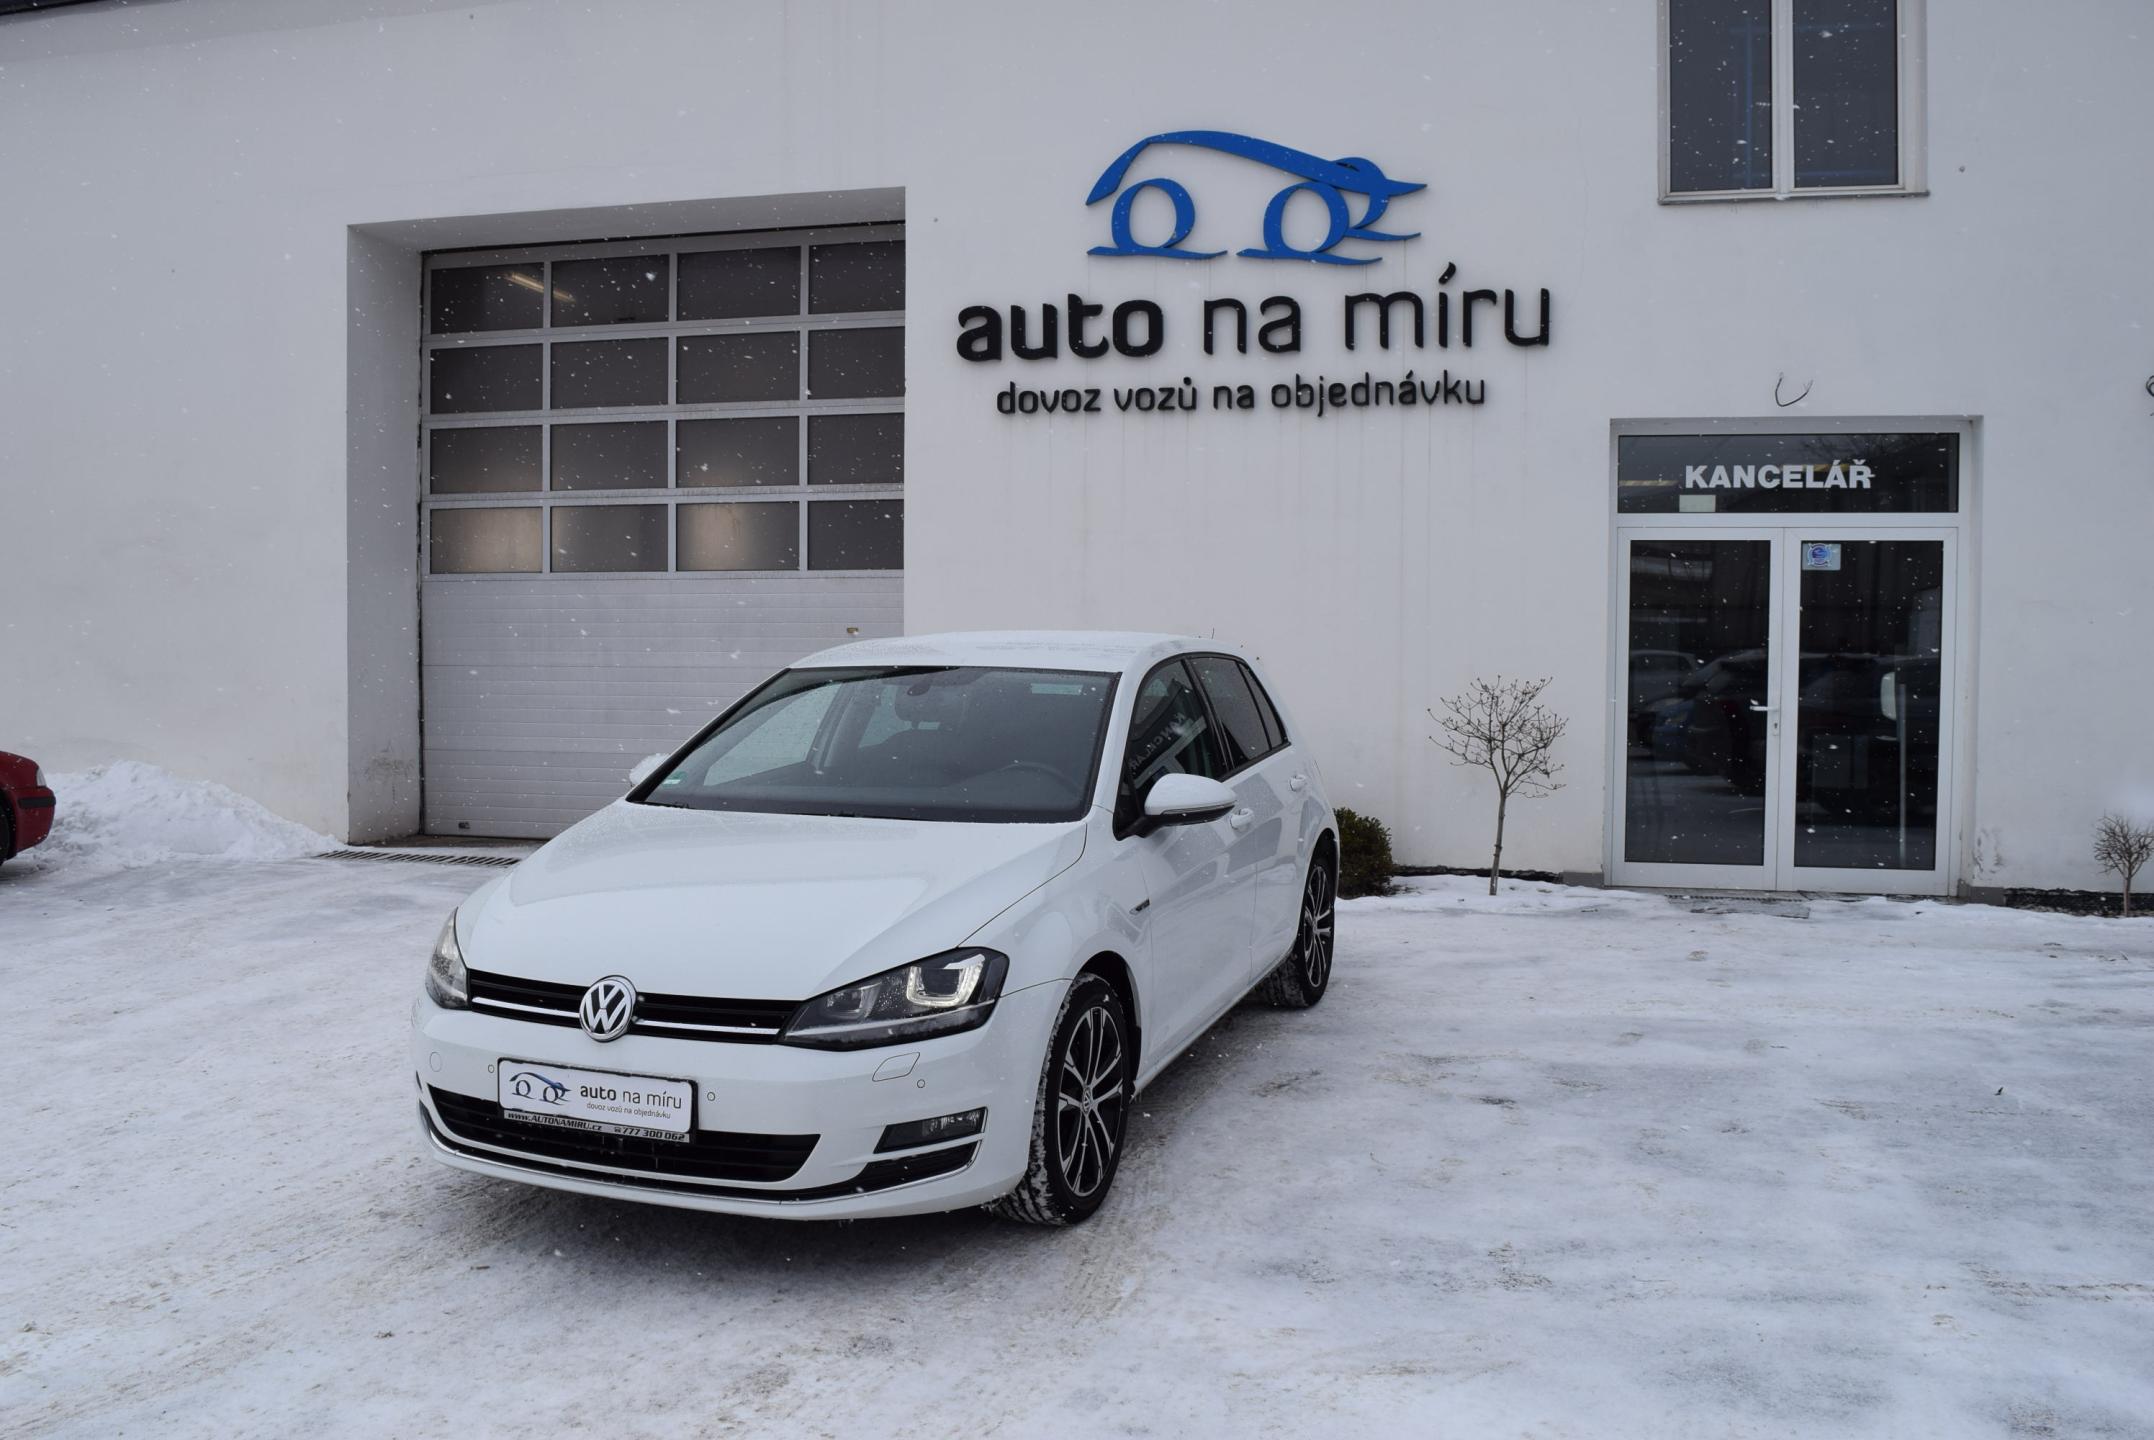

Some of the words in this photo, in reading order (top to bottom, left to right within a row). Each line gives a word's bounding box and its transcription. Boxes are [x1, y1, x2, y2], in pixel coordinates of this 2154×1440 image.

[956, 293, 1163, 361] auto
[1203, 296, 1300, 355] na
[1344, 261, 1550, 350] míru
[996, 381, 1101, 414] dovoz
[1113, 376, 1197, 412] vozů
[1213, 384, 1255, 409] na
[1271, 369, 1485, 417] objednávku
[1685, 459, 1872, 489] KANCELÁŘ
[580, 1085, 617, 1101] auto
[622, 1090, 641, 1104] na
[646, 1090, 682, 1109] míru
[586, 1102, 606, 1111] dovoz
[624, 1107, 633, 1115] na
[634, 1108, 671, 1119] objednávku
[642, 1129, 663, 1139] 300
